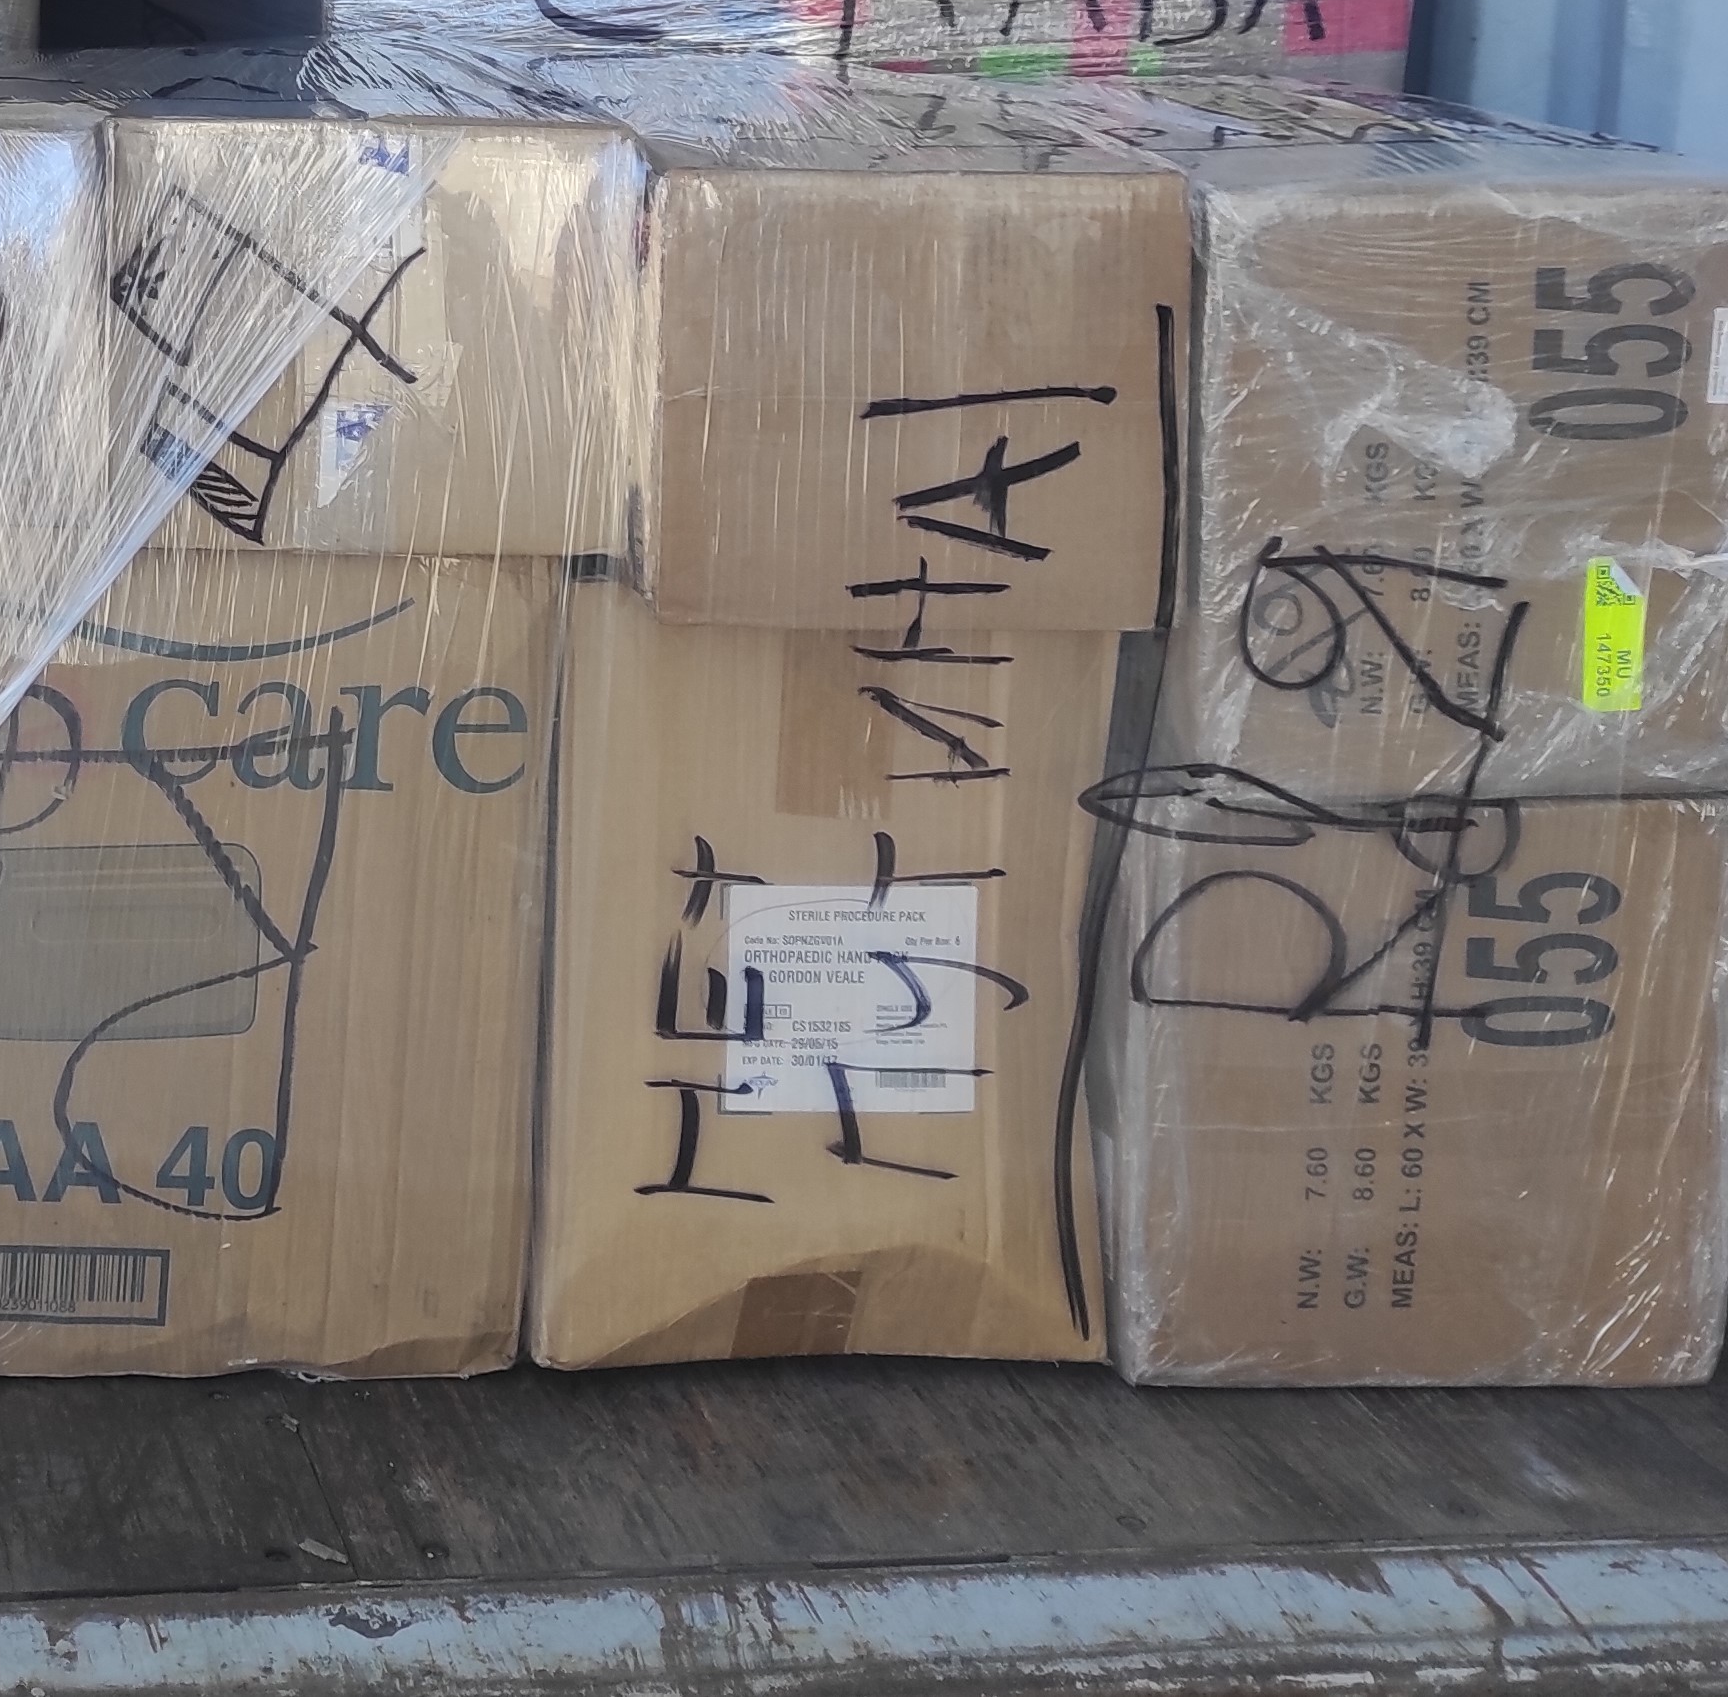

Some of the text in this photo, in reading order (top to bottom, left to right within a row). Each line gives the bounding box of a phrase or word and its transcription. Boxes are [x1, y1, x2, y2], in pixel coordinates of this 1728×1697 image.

[1467, 280, 1492, 327] CM
[1527, 262, 1697, 441] 055
[1595, 632, 1612, 699] 147350
[1615, 649, 1632, 680] MU
[120, 678, 528, 795] care
[788, 909, 927, 923] STERILE PROCEDURE PACK
[743, 951, 833, 965] ORTHOPAEDIC
[836, 951, 872, 965] HAND
[744, 935, 764, 946] Code
[1459, 870, 1622, 1047] 055
[768, 970, 866, 985] GORDON VEALE
[742, 1056, 759, 1067] EXP
[760, 1056, 785, 1067] DATE:
[1404, 1077, 1429, 1118] W:
[1404, 1121, 1425, 1140] X
[155, 1125, 278, 1211] 40
[1296, 1042, 1336, 1310] N.W: 7.60 KGS
[1343, 1042, 1384, 1310] G.W: 8.60 KGS
[1400, 1146, 1424, 1179] 60
[1391, 1220, 1420, 1309] MEAS:
